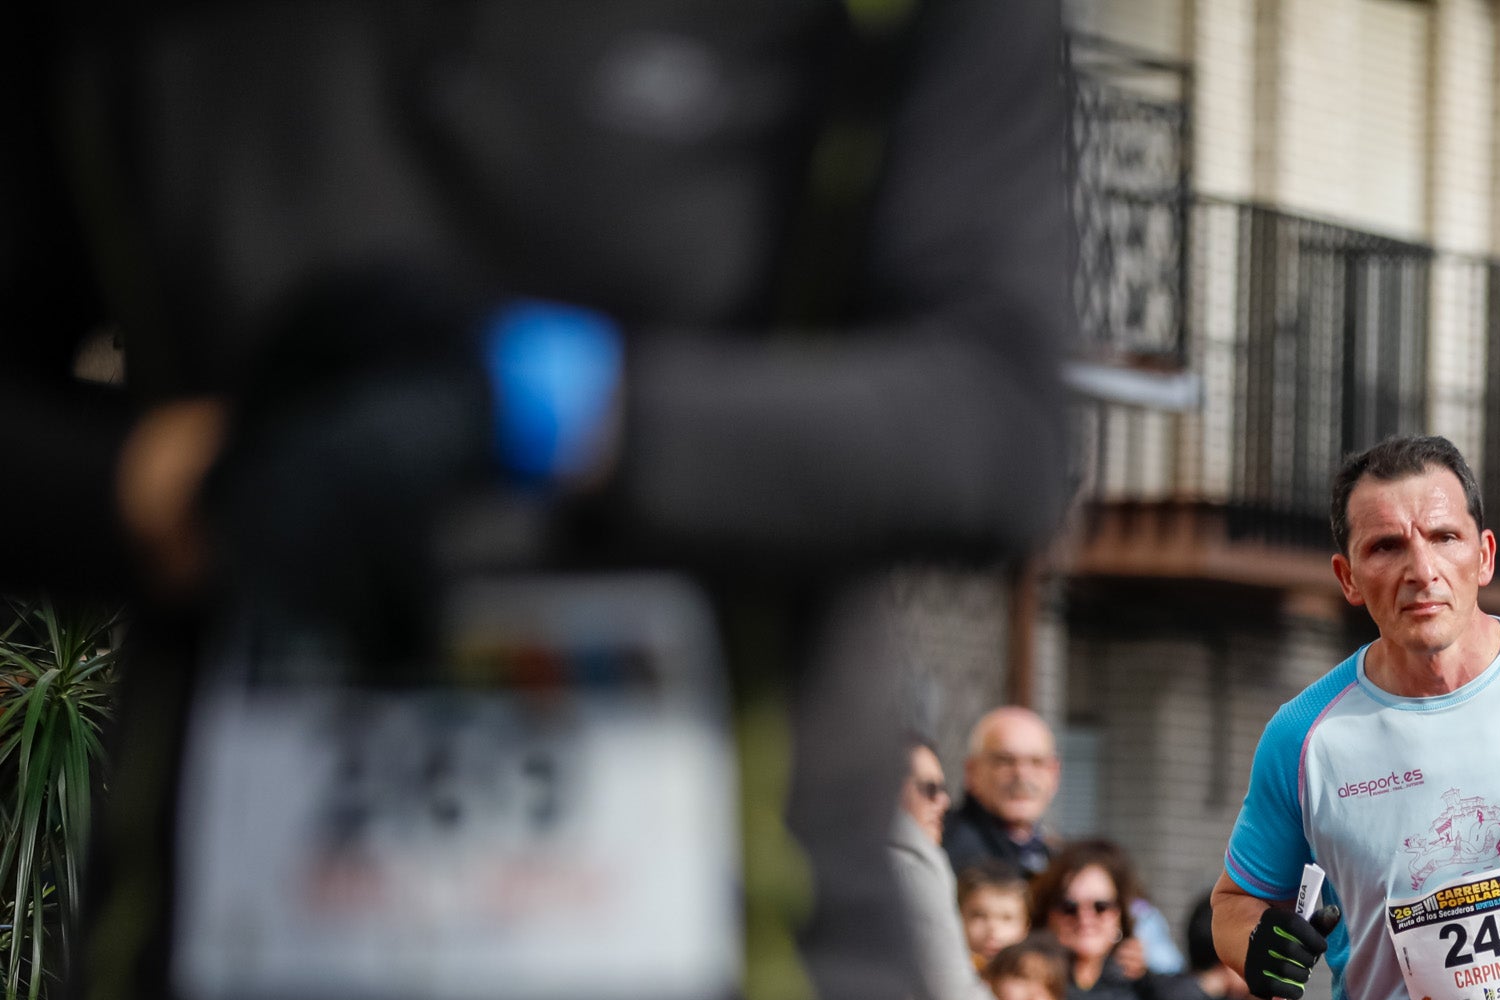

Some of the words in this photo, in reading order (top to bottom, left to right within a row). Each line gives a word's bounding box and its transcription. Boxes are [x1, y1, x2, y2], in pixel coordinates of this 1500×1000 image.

[1338, 769, 1423, 798] alssport.es
[1297, 884, 1307, 914] VEGA
[1436, 879, 1500, 901] CARRERA
[1439, 889, 1500, 909] POPULAR
[1394, 907, 1412, 920] 26
[1423, 895, 1439, 912] VII
[1398, 919, 1414, 930] Ruta
[1416, 914, 1425, 923] de
[1426, 911, 1437, 921] los
[1438, 905, 1475, 918] Secaderos
